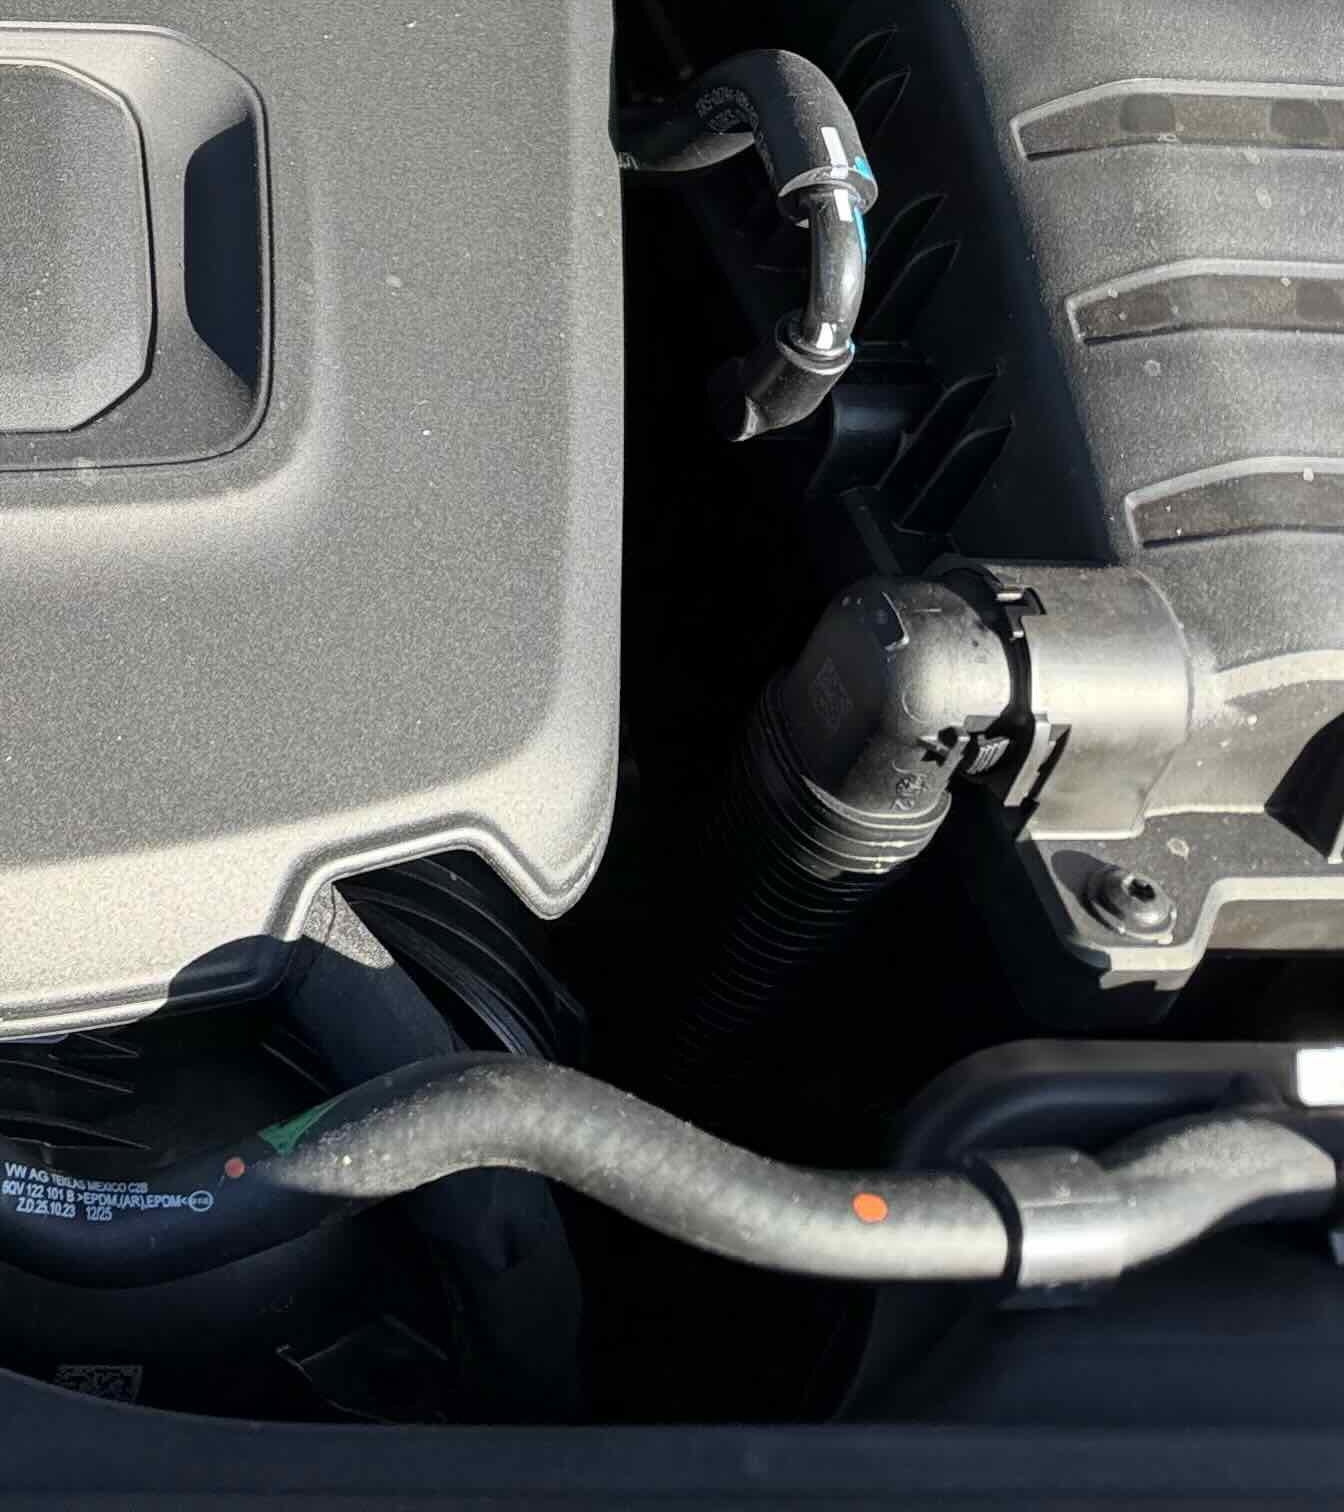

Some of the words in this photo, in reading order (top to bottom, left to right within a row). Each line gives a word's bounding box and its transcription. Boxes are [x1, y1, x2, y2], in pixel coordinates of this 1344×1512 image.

[3, 1162, 28, 1179] VW
[28, 1167, 50, 1184] AG
[25, 1182, 45, 1200] 122
[46, 1186, 65, 1202] 101
[66, 1189, 75, 1203] B
